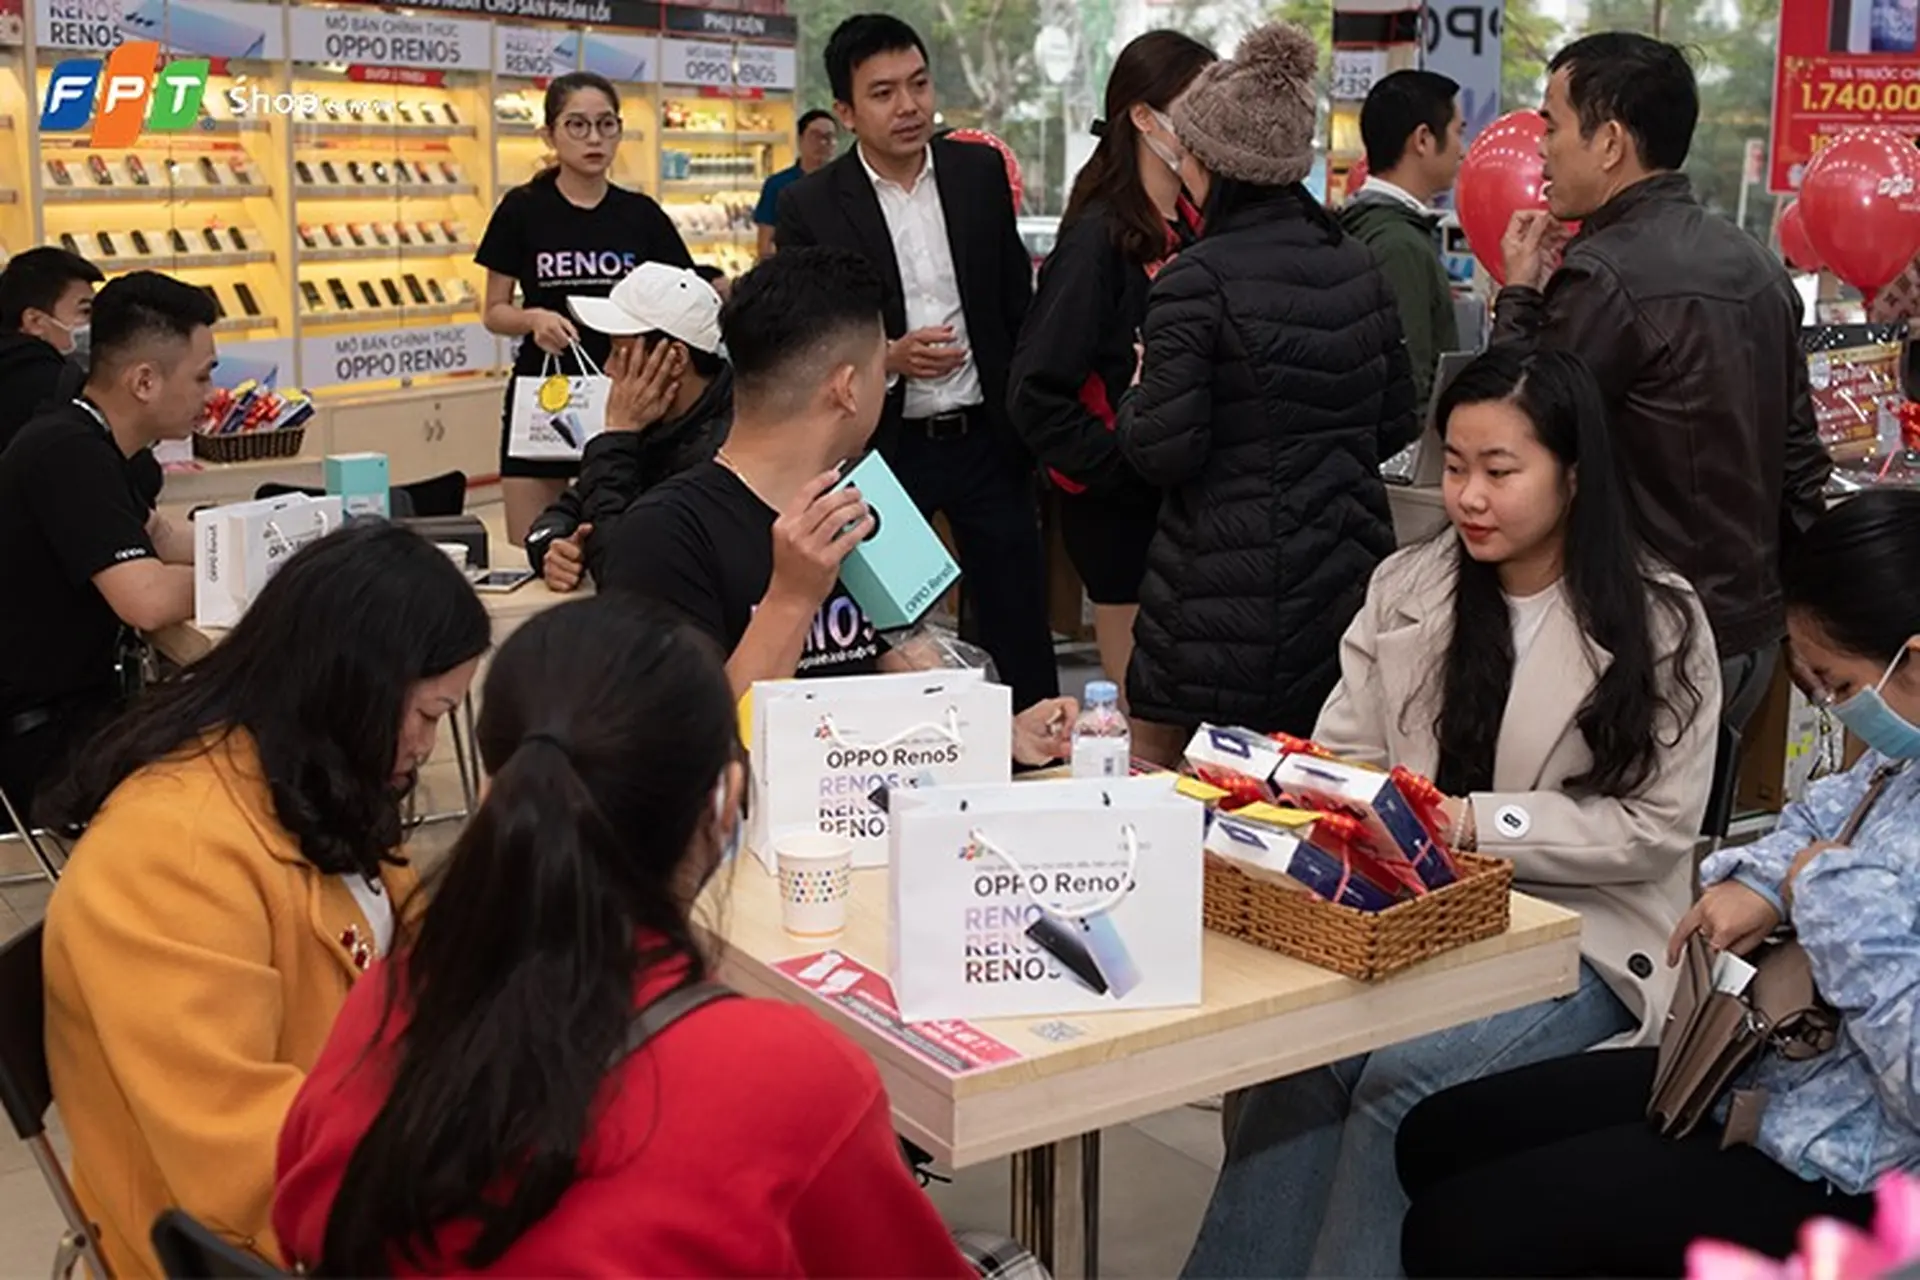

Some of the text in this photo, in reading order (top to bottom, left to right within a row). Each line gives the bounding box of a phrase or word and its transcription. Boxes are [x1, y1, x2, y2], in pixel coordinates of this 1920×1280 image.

[326, 34, 462, 63] OPPO RENO5
[685, 60, 728, 82] OPPO
[336, 345, 467, 380] OPPO RENO5
[826, 744, 959, 769] OPPO Reno5
